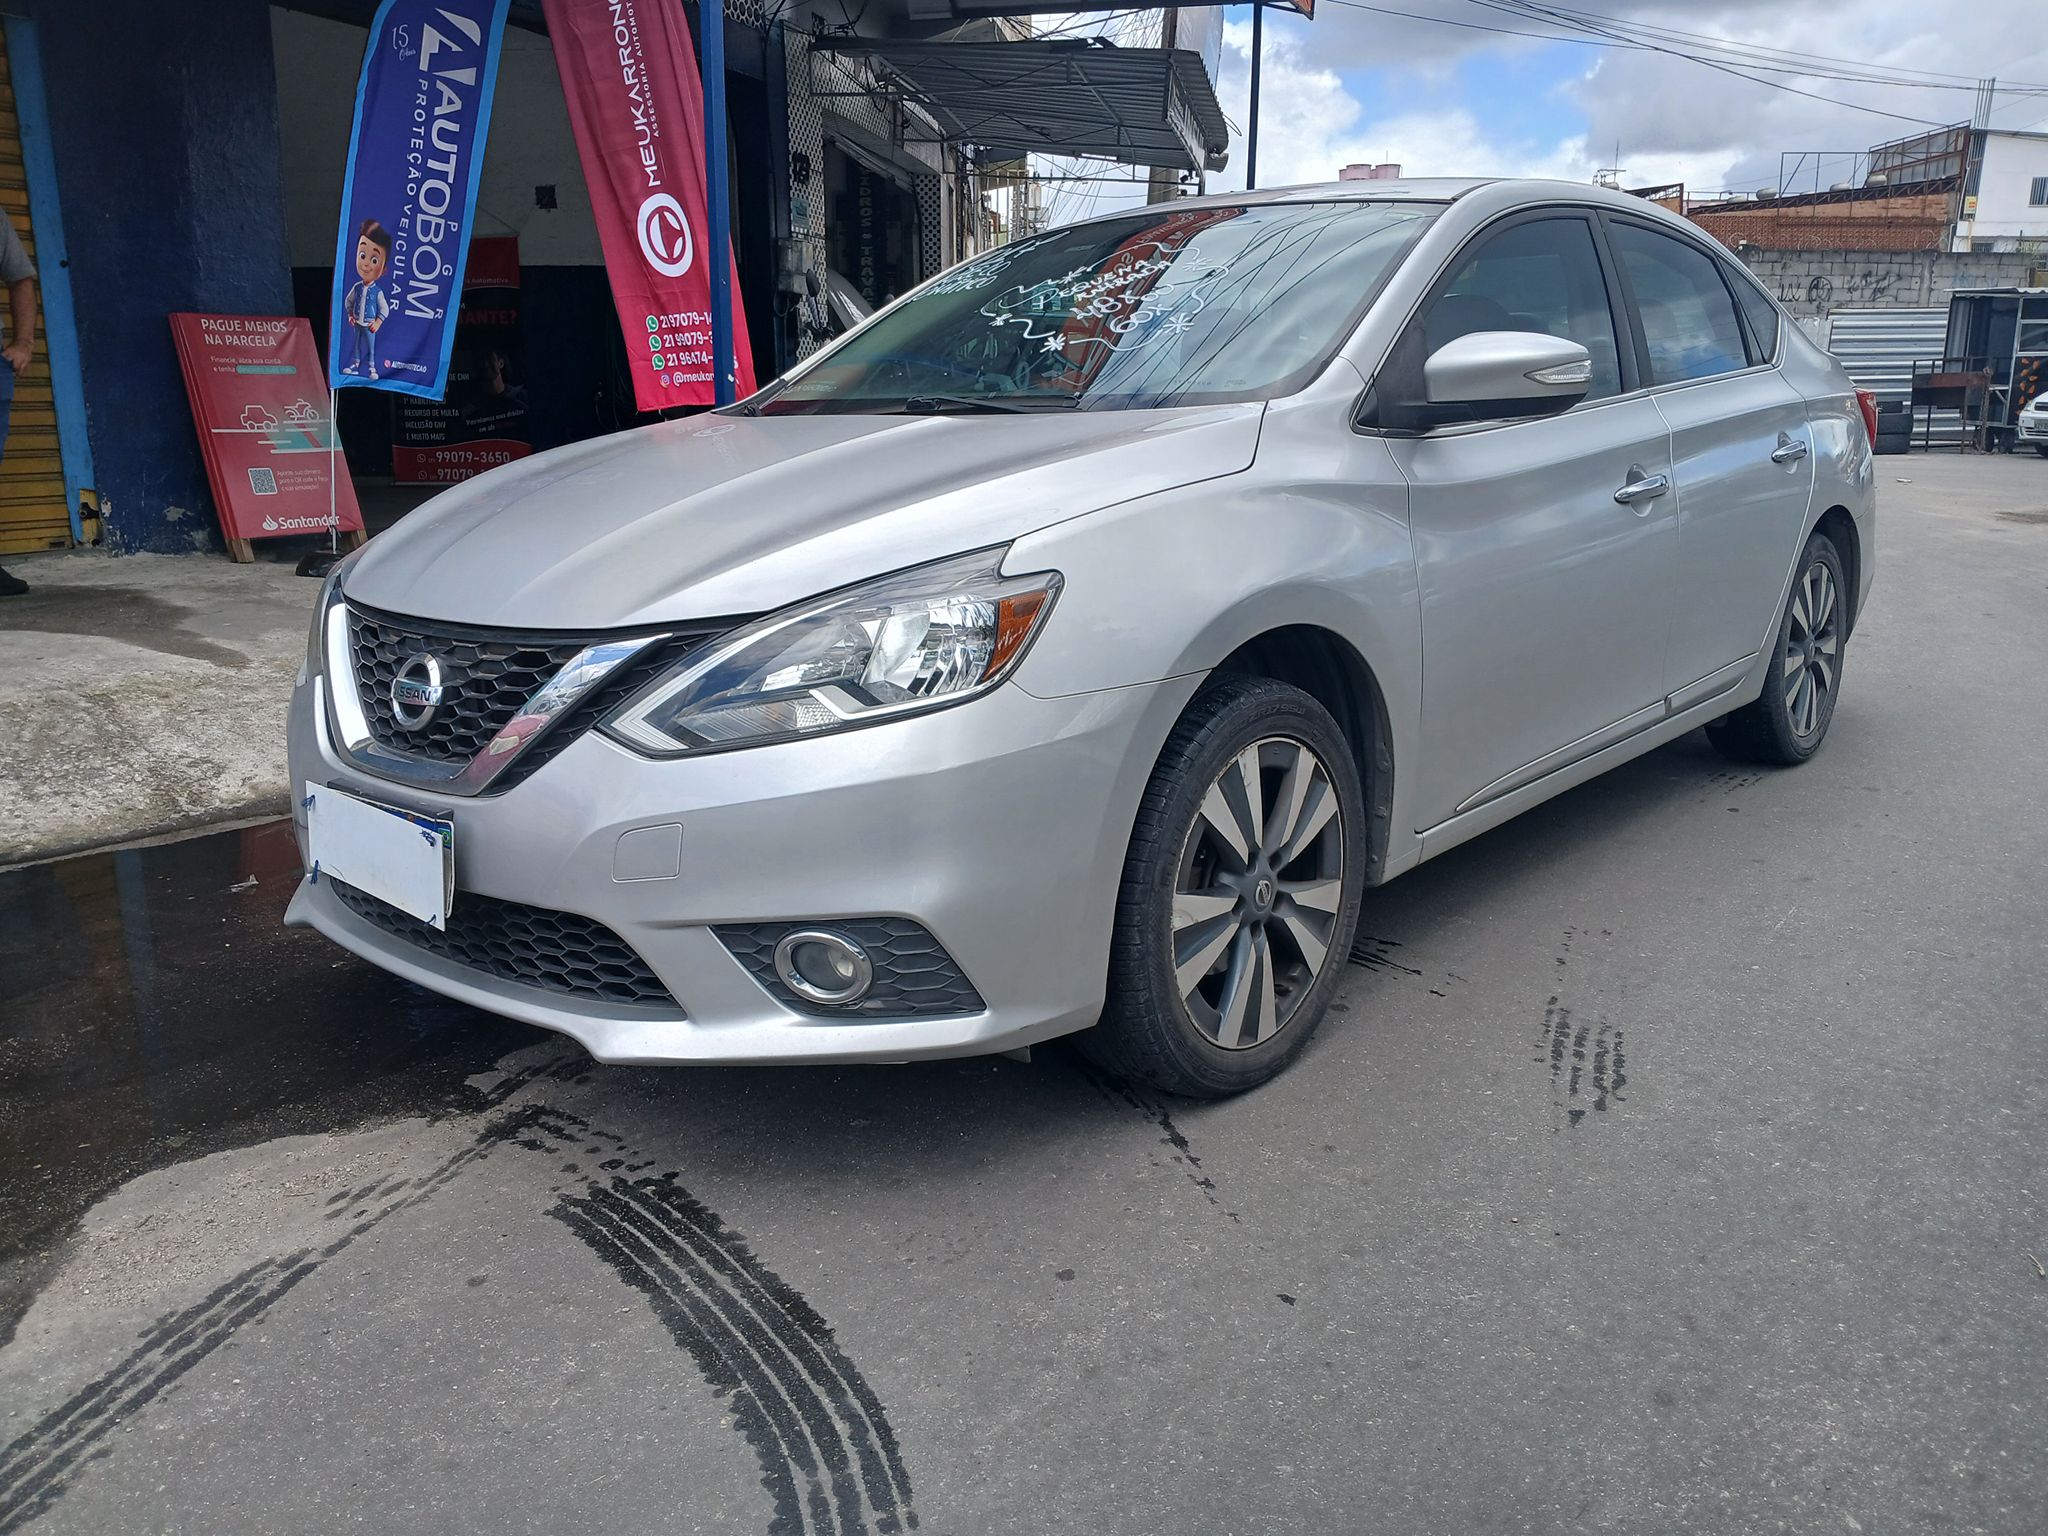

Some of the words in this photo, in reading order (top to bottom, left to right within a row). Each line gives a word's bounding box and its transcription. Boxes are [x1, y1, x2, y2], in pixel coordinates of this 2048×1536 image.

[626, 0, 644, 57] AUTOMOT
[608, 0, 661, 186] MEUKARRON
[639, 62, 660, 138] ASSESSORIA
[407, 78, 428, 197] PROTEÇÃO
[405, 80, 463, 320] AUTOBOM
[390, 205, 413, 311] VEICULAR
[200, 318, 242, 332] PAGUE
[245, 321, 288, 333] MENOS
[204, 334, 223, 345] NA
[225, 335, 277, 347] PARCELA
[667, 353, 678, 367] 21
[679, 351, 714, 365] 96474-
[436, 452, 511, 463] 99079-3650
[396, 686, 432, 702] SSAN
